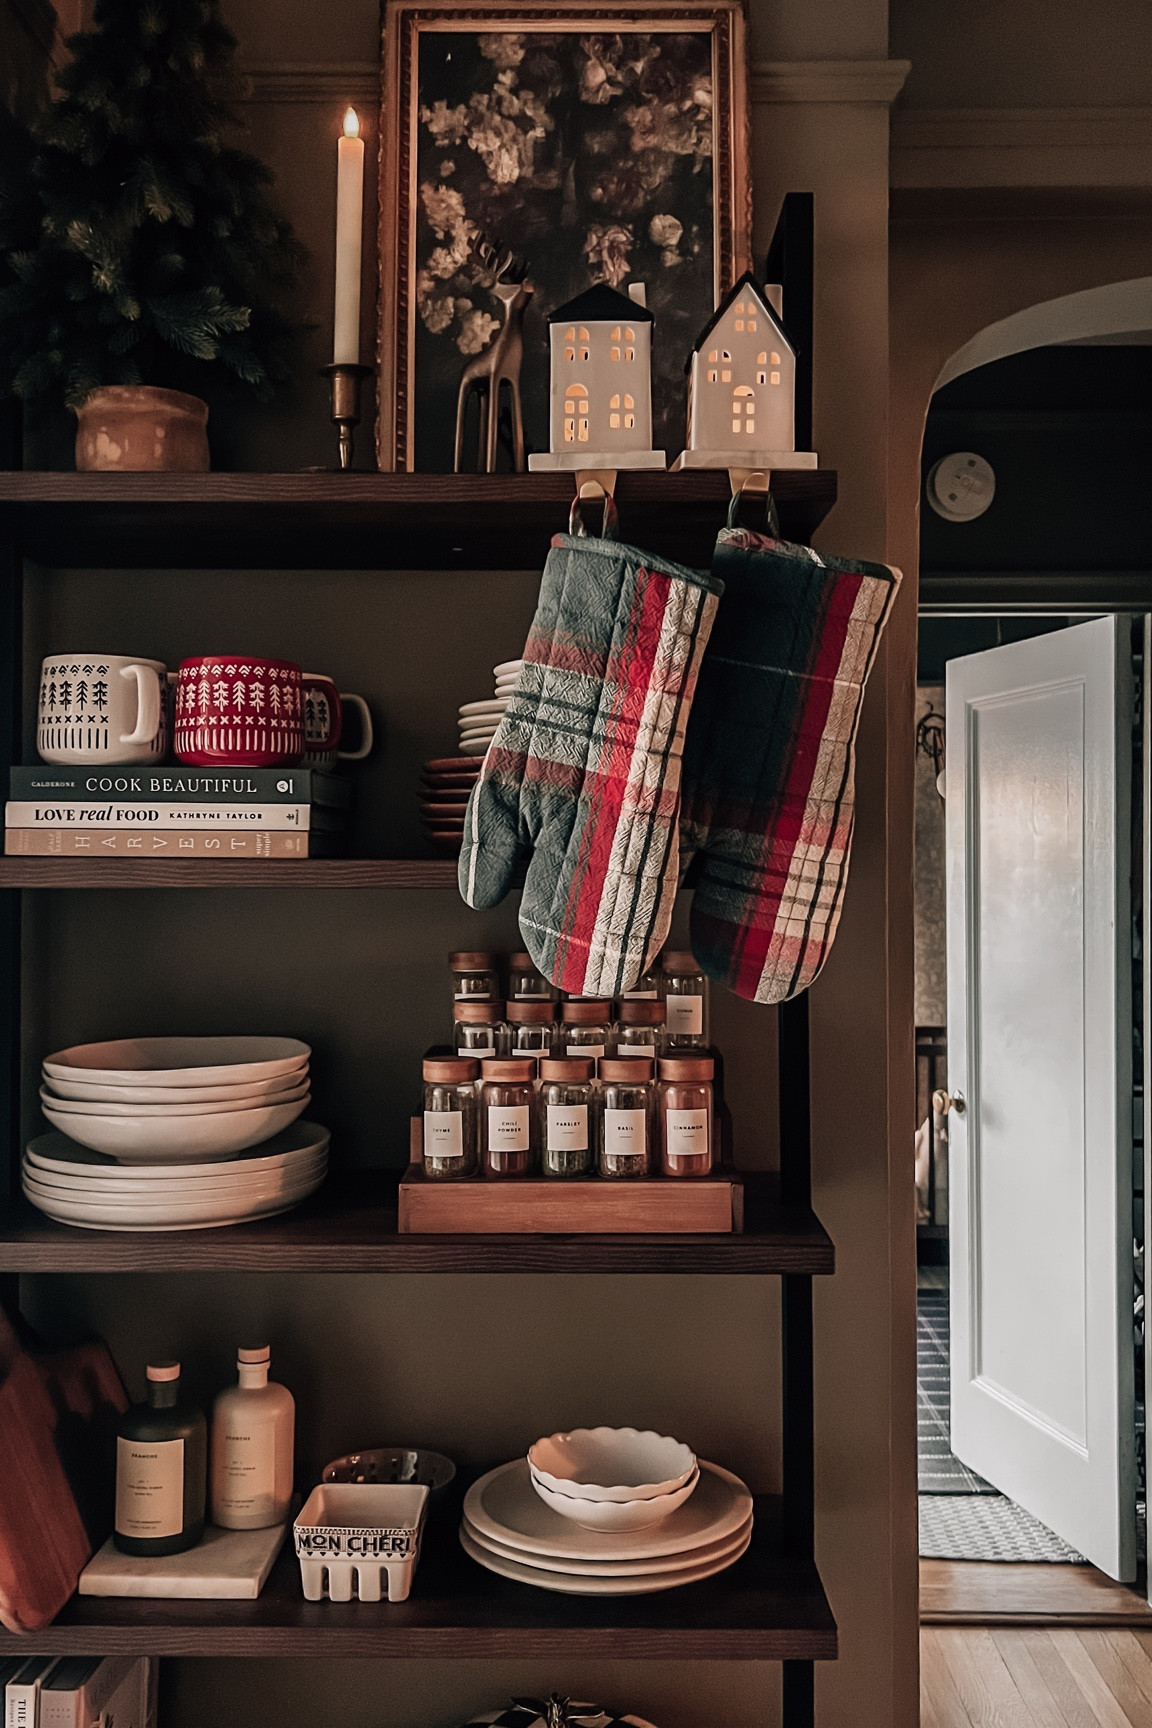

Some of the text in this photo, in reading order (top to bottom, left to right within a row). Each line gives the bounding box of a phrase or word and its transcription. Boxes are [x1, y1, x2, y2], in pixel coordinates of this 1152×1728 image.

[86, 778, 257, 793] COOK BEAUTIFUL
[35, 806, 159, 821] LOVE real FOOD
[75, 836, 246, 850] HARVEST
[263, 832, 271, 857] simple
[299, 1535, 341, 1549] MON
[18, 1699, 26, 1723] THE
